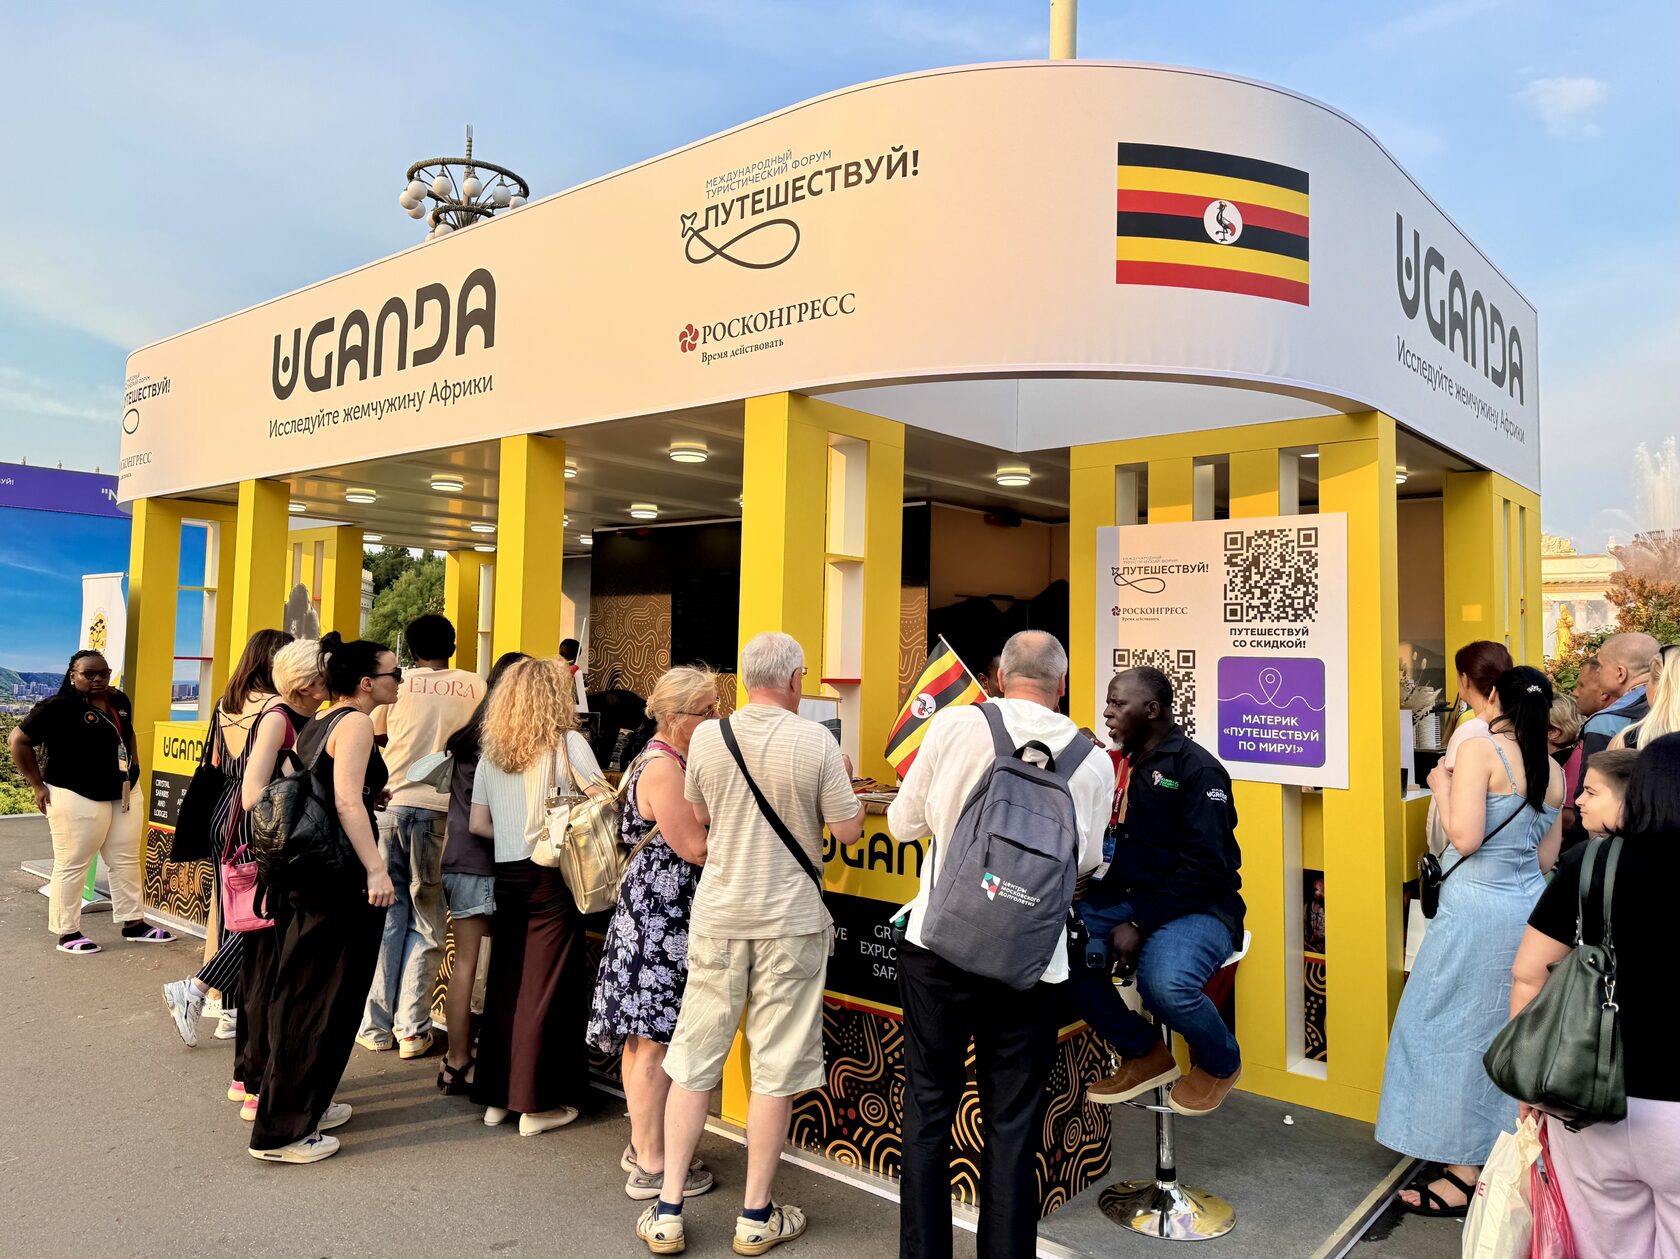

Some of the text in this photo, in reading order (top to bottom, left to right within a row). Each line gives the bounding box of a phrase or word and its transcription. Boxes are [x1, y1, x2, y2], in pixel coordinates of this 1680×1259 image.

[706, 149, 792, 188] МЕЖДУНАРОДНЫЙ
[706, 149, 832, 199] ТУРИСТИЧЕСКИЙ ФОРУМ
[703, 144, 919, 229] ПУТЕШЕСТВУЙ!
[701, 293, 856, 344] РОСКОНГРЕСС
[1396, 211, 1524, 406] UGANDA
[272, 267, 497, 401] UGANDA
[701, 338, 784, 365] Время действовать
[1397, 335, 1525, 445] Исследуйте жемчужину Африки
[269, 374, 493, 438] Исследуйте жемчужину Африки
[0, 478, 14, 486] УЙ!
[1122, 562, 1209, 575] ПУТЕШЕСТВУЙ!
[1122, 607, 1188, 615] РОСКОНГРЕСС
[1230, 626, 1309, 636] ПУТЕШЕСТВУЙ
[1232, 638, 1306, 649] СО СКИДКОЙ!
[409, 677, 475, 699] ELORA
[1242, 714, 1299, 727] МАТЕРИК
[1223, 727, 1319, 742] «ПУТЕШЕСТВУЙ
[163, 735, 205, 763] UGAND
[1238, 741, 1304, 754] ПО МИРУ!»
[822, 830, 929, 878] UGAN
[834, 927, 848, 941] VE
[874, 925, 892, 940] GR
[860, 941, 897, 961] EXPLO
[873, 963, 898, 981] SAF
